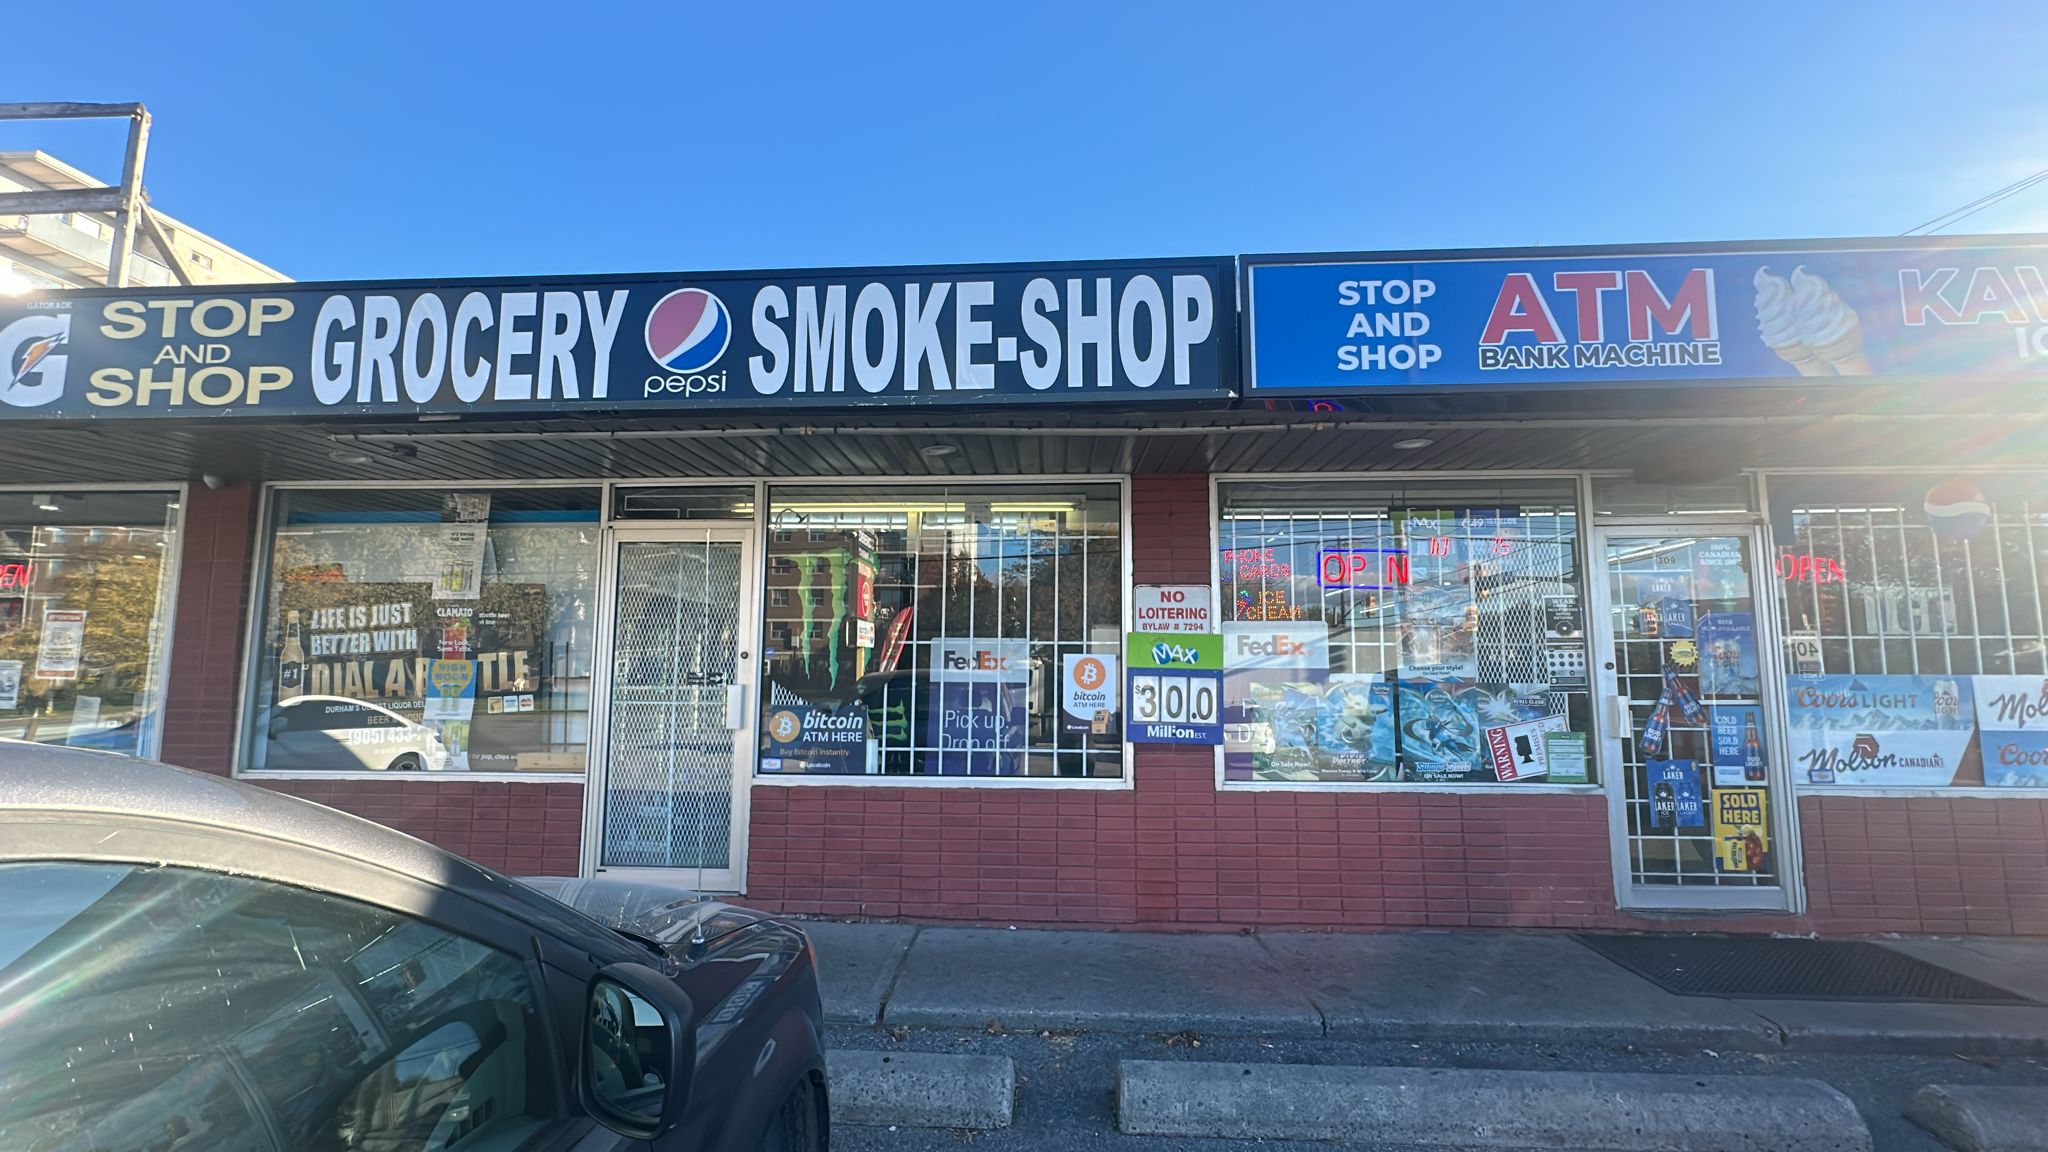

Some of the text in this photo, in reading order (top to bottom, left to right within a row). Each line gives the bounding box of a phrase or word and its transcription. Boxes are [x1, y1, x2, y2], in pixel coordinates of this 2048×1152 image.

[1338, 280, 1437, 306] STOP
[1479, 268, 1719, 345] ATM
[100, 298, 295, 340] STOP
[1346, 312, 1430, 337] AND
[749, 274, 1213, 396] SMOKE-SHOP
[153, 344, 231, 365] AND
[311, 289, 630, 406] GROCERY
[1337, 344, 1442, 370] SHOP
[1479, 341, 1722, 370] BANK MACHINE
[86, 366, 295, 406] SHOP
[644, 370, 727, 398] pepsi
[1776, 553, 1845, 584] OPEN
[1160, 591, 1185, 602] NO
[1258, 590, 1285, 604] ICE
[310, 602, 413, 630] LIFE IS JUST
[436, 608, 473, 616] CLAMATO
[1139, 608, 1207, 619] LOITERING
[1184, 623, 1203, 631] 7294
[373, 628, 417, 652] WITH
[1237, 635, 1305, 656] FedEx
[943, 651, 1006, 670] FedEx
[1152, 643, 1196, 665] MAX
[283, 668, 298, 679] #1
[311, 661, 379, 698] DIAL
[385, 658, 406, 698] A
[1074, 691, 1106, 701] bitcoin
[1798, 686, 1918, 709] Coors LIGHT
[803, 712, 863, 729] bitcoin
[945, 709, 979, 728] Pick
[1716, 716, 1737, 724] COLD
[802, 732, 863, 742] ATM HERE
[1718, 726, 1737, 735] BEER
[1718, 736, 1738, 745] SOLD
[780, 748, 792, 756] Buy
[1490, 728, 1513, 779] WARNING
[1719, 747, 1739, 755] HERE
[1799, 747, 1940, 773] Molson CANADIAN
[1663, 771, 1684, 780] LAKER
[1722, 794, 1757, 808] SOLD
[1723, 809, 1759, 823] HERE
